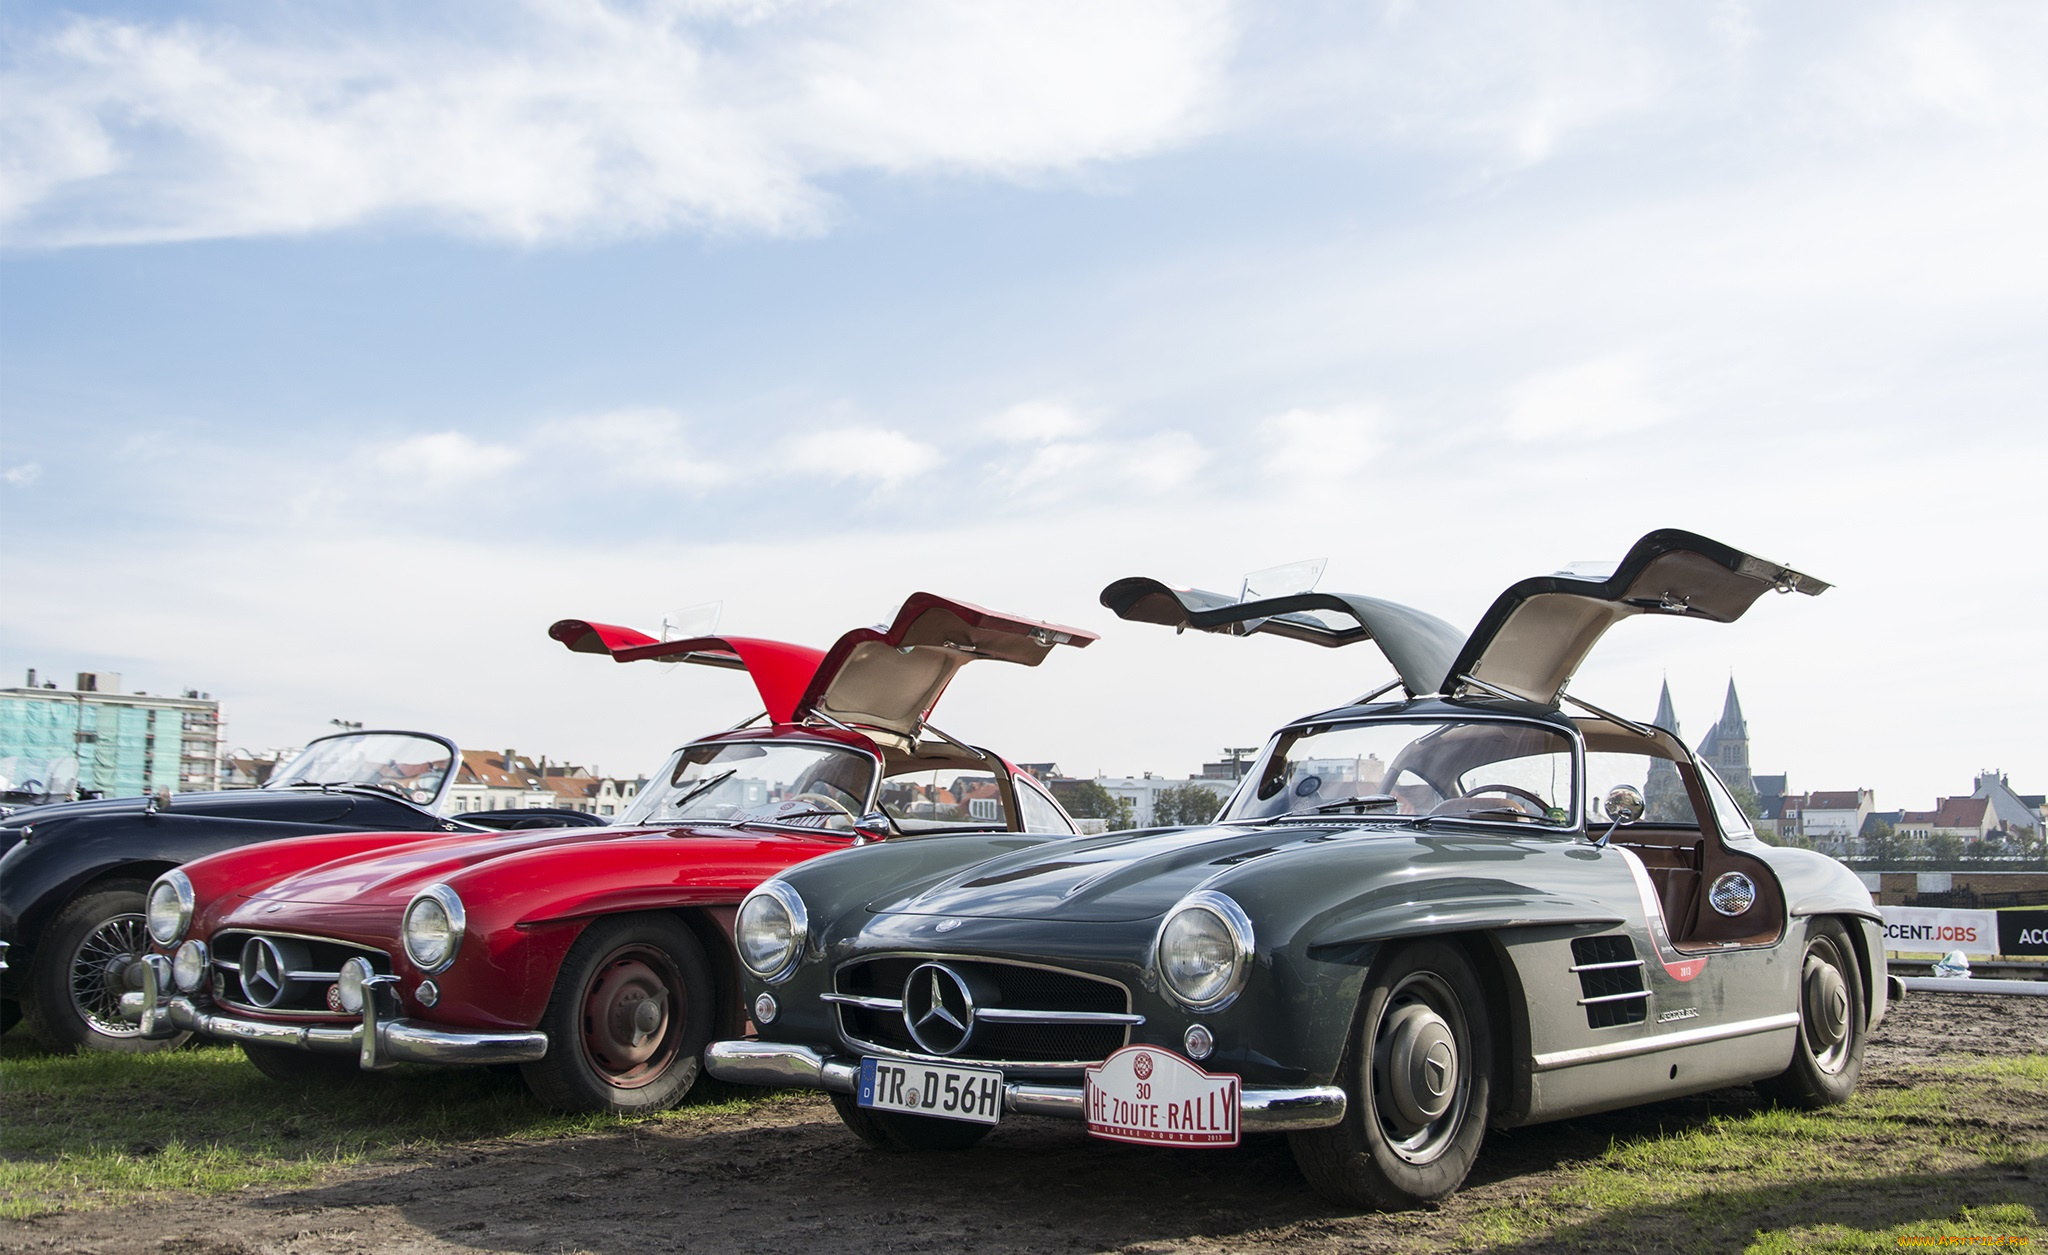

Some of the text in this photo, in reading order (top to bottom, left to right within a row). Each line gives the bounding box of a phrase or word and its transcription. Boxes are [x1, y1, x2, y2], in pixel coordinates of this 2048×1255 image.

[1883, 924, 1977, 942] CENT.JOBS
[863, 1087, 871, 1098] D
[877, 1065, 906, 1105] TR
[1136, 1083, 1151, 1100] 30
[1088, 1075, 1233, 1131] THE ZOUTE RALLY
